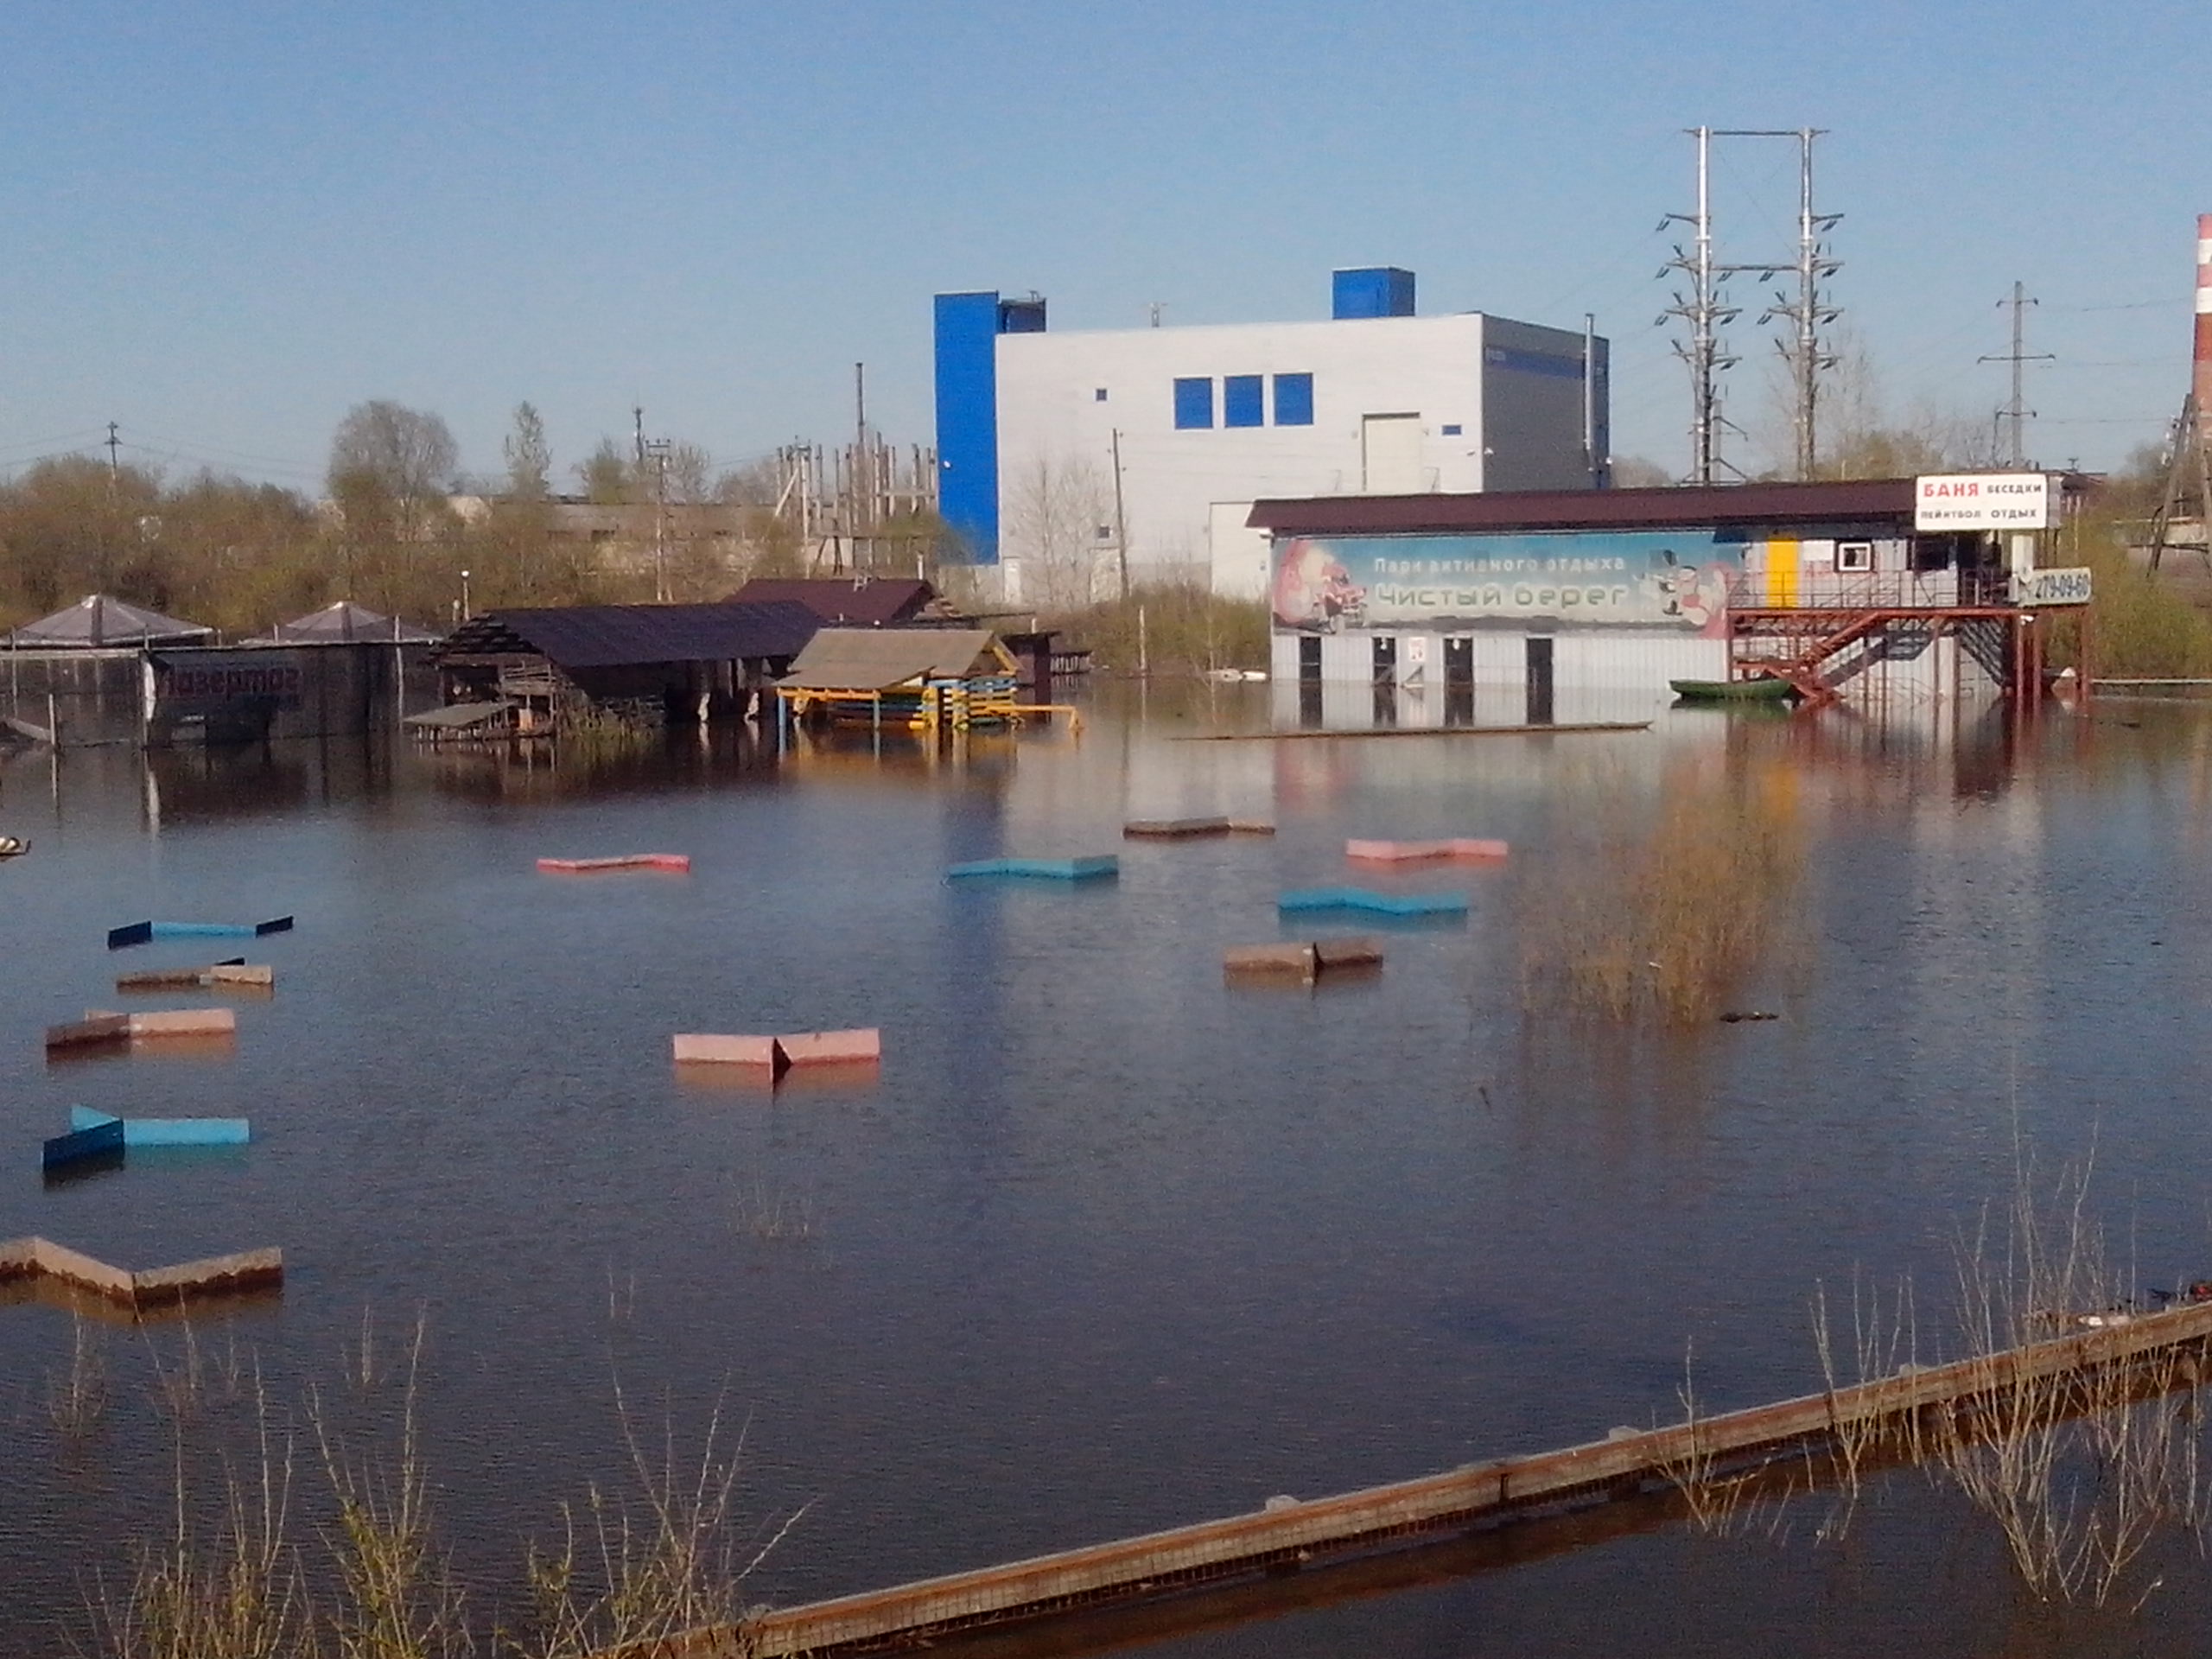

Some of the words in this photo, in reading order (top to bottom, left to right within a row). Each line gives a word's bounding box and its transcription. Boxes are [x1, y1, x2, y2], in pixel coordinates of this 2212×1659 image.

[1923, 482, 1979, 498] БАНЯ
[1987, 484, 2042, 495] БЕСЕДКИ
[1921, 509, 1981, 519] ПЕЙНТБОЛ
[1991, 509, 2037, 519] ОТДЫХ
[1375, 557, 1421, 574] Парк
[1429, 558, 1537, 573] активного
[1546, 557, 1625, 572] отдыха
[1376, 583, 1502, 606] Чистый
[1514, 582, 1629, 609] берег
